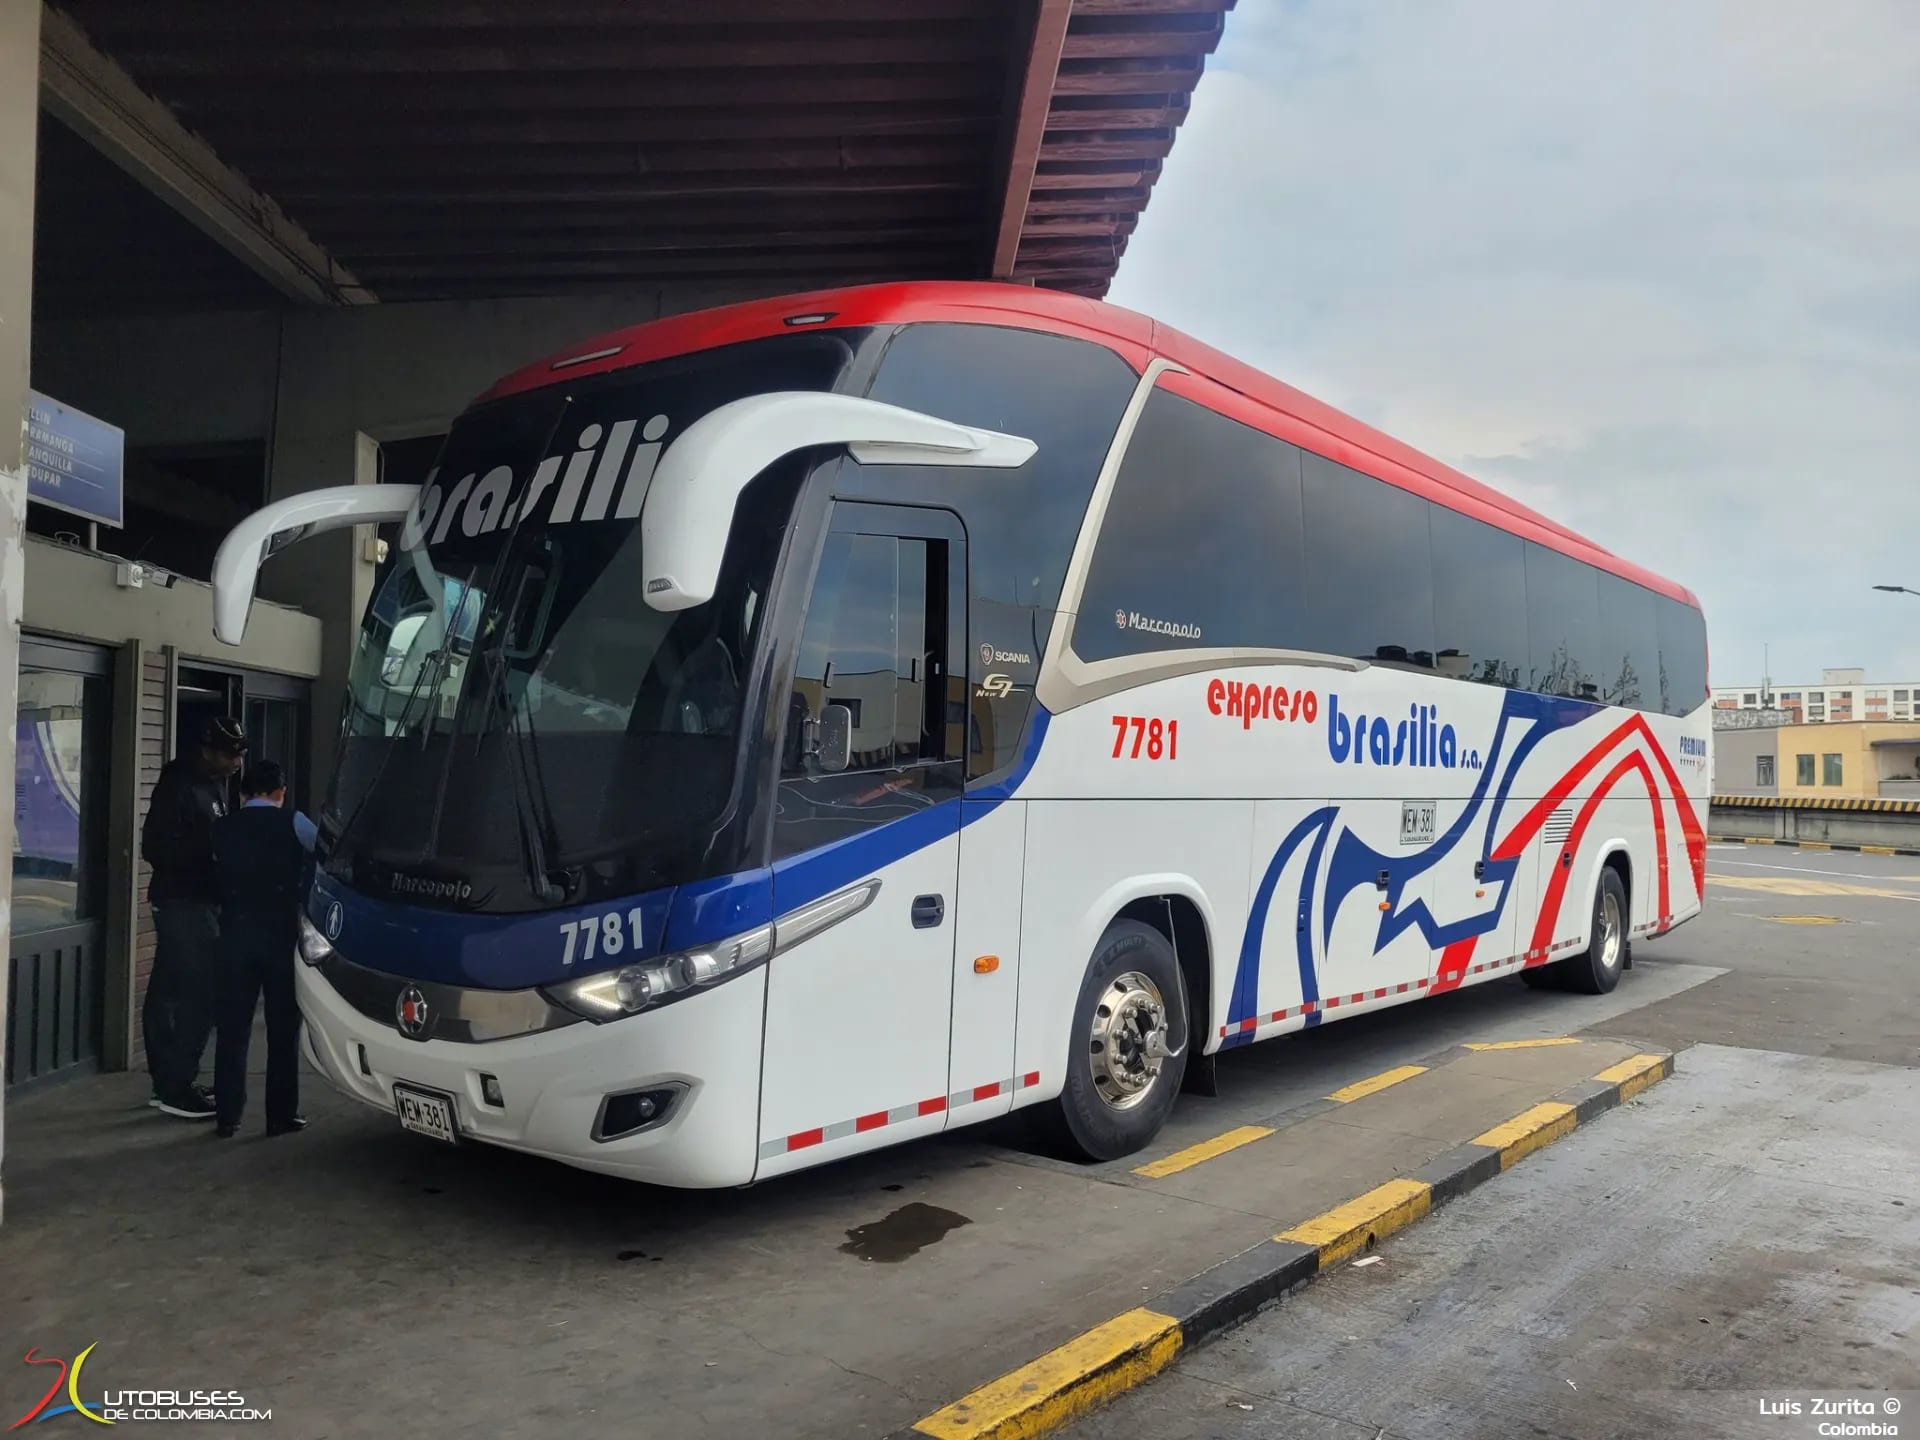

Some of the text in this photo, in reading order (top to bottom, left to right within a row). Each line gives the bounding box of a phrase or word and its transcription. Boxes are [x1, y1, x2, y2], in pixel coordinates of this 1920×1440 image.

[400, 413, 670, 551] brasili
[1128, 612, 1201, 640] Marcopolo
[994, 650, 1031, 664] SCANIA
[1112, 715, 1178, 760] 7781
[1207, 678, 1318, 730] expreso
[1328, 694, 1456, 769] brasilia
[560, 907, 644, 965] 7781
